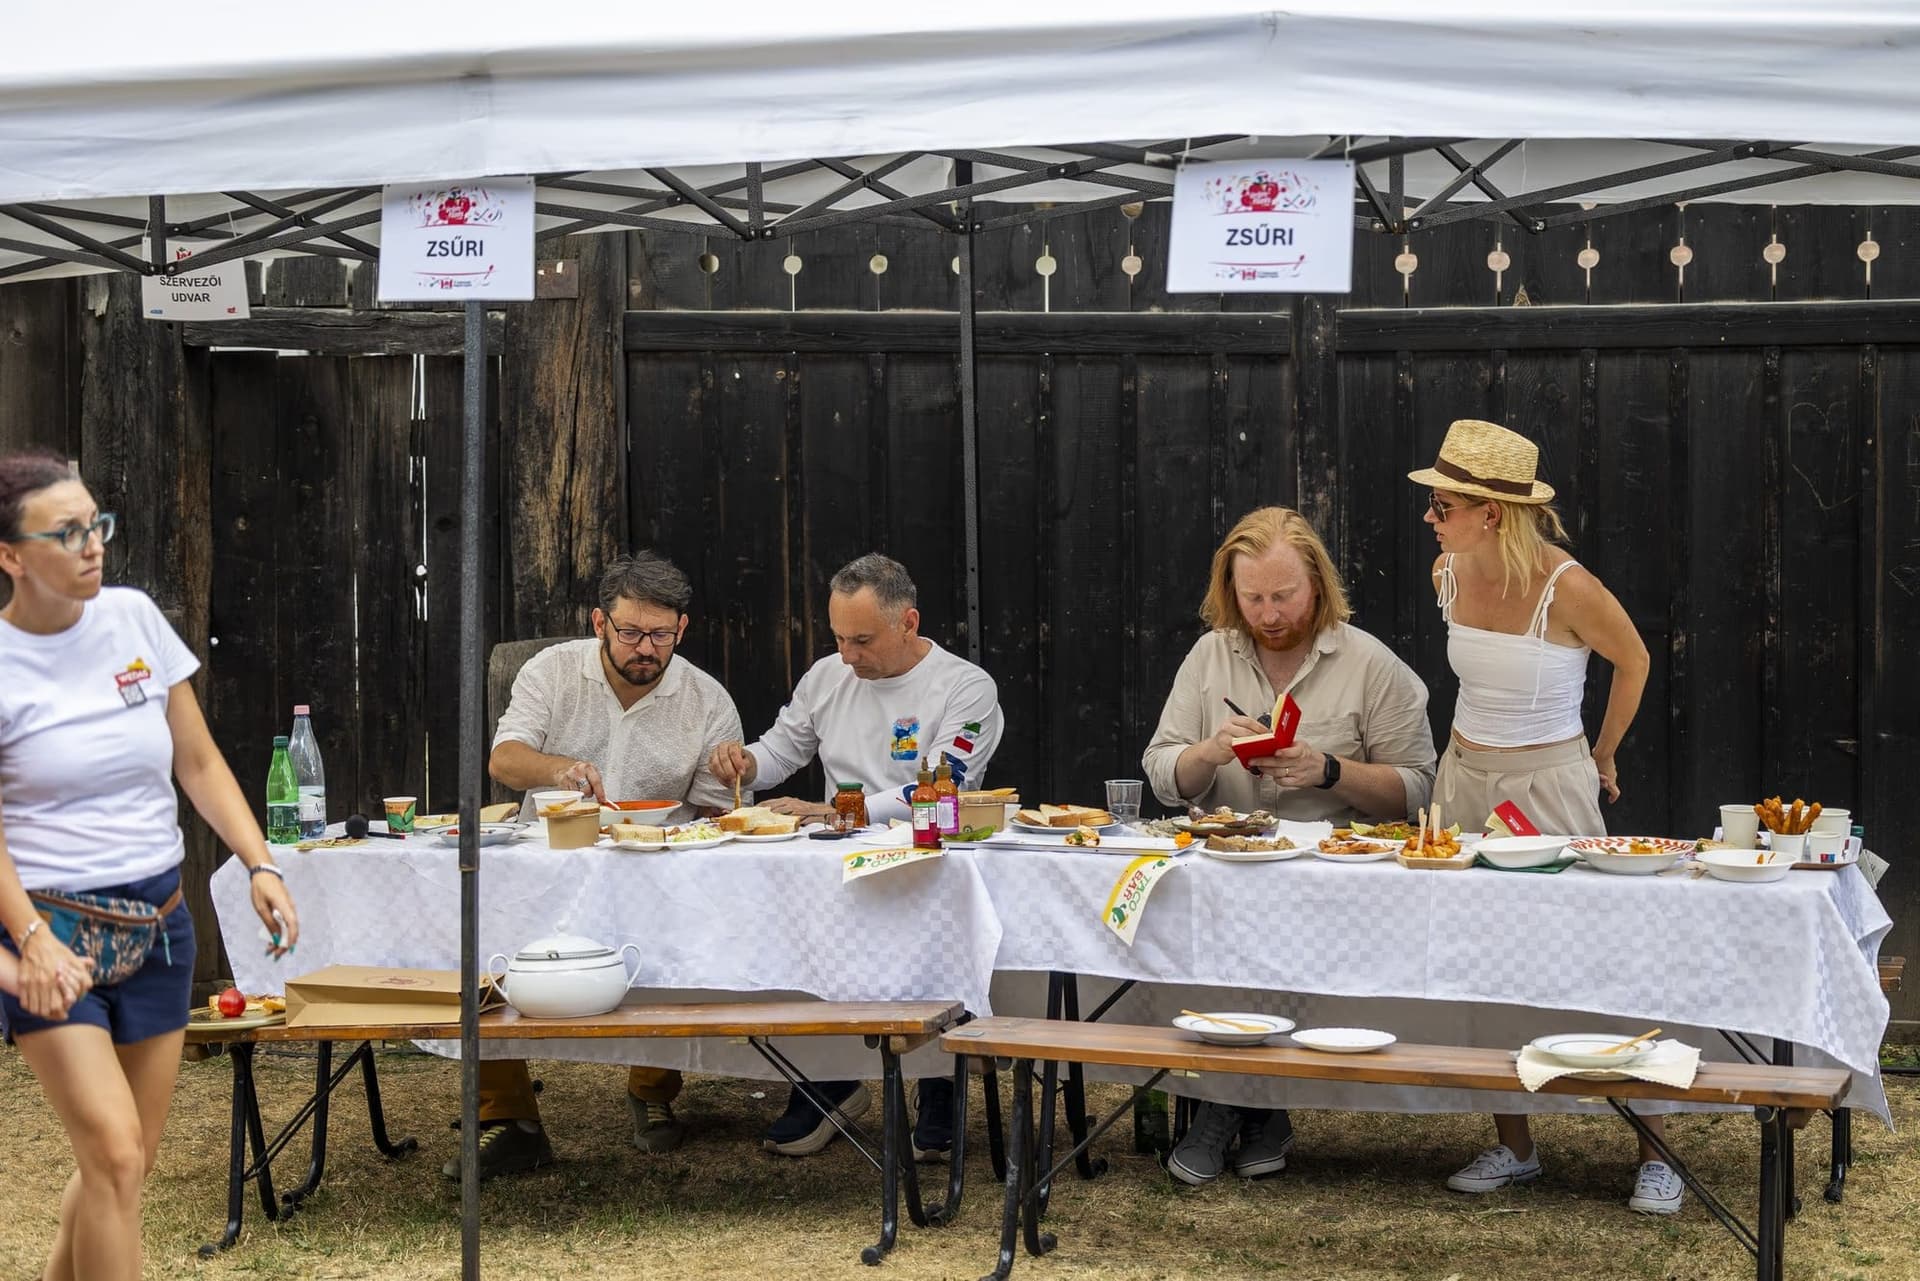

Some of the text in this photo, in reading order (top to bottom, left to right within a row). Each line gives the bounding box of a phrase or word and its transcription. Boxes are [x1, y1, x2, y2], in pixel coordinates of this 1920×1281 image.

[1226, 223, 1294, 246] ZSŰRI
[426, 235, 484, 257] ZSŰRI
[159, 275, 222, 287] SZERVEZŐI
[171, 292, 211, 303] UDVAR
[1123, 869, 1144, 901] BAR
[1128, 874, 1152, 911] TACO
